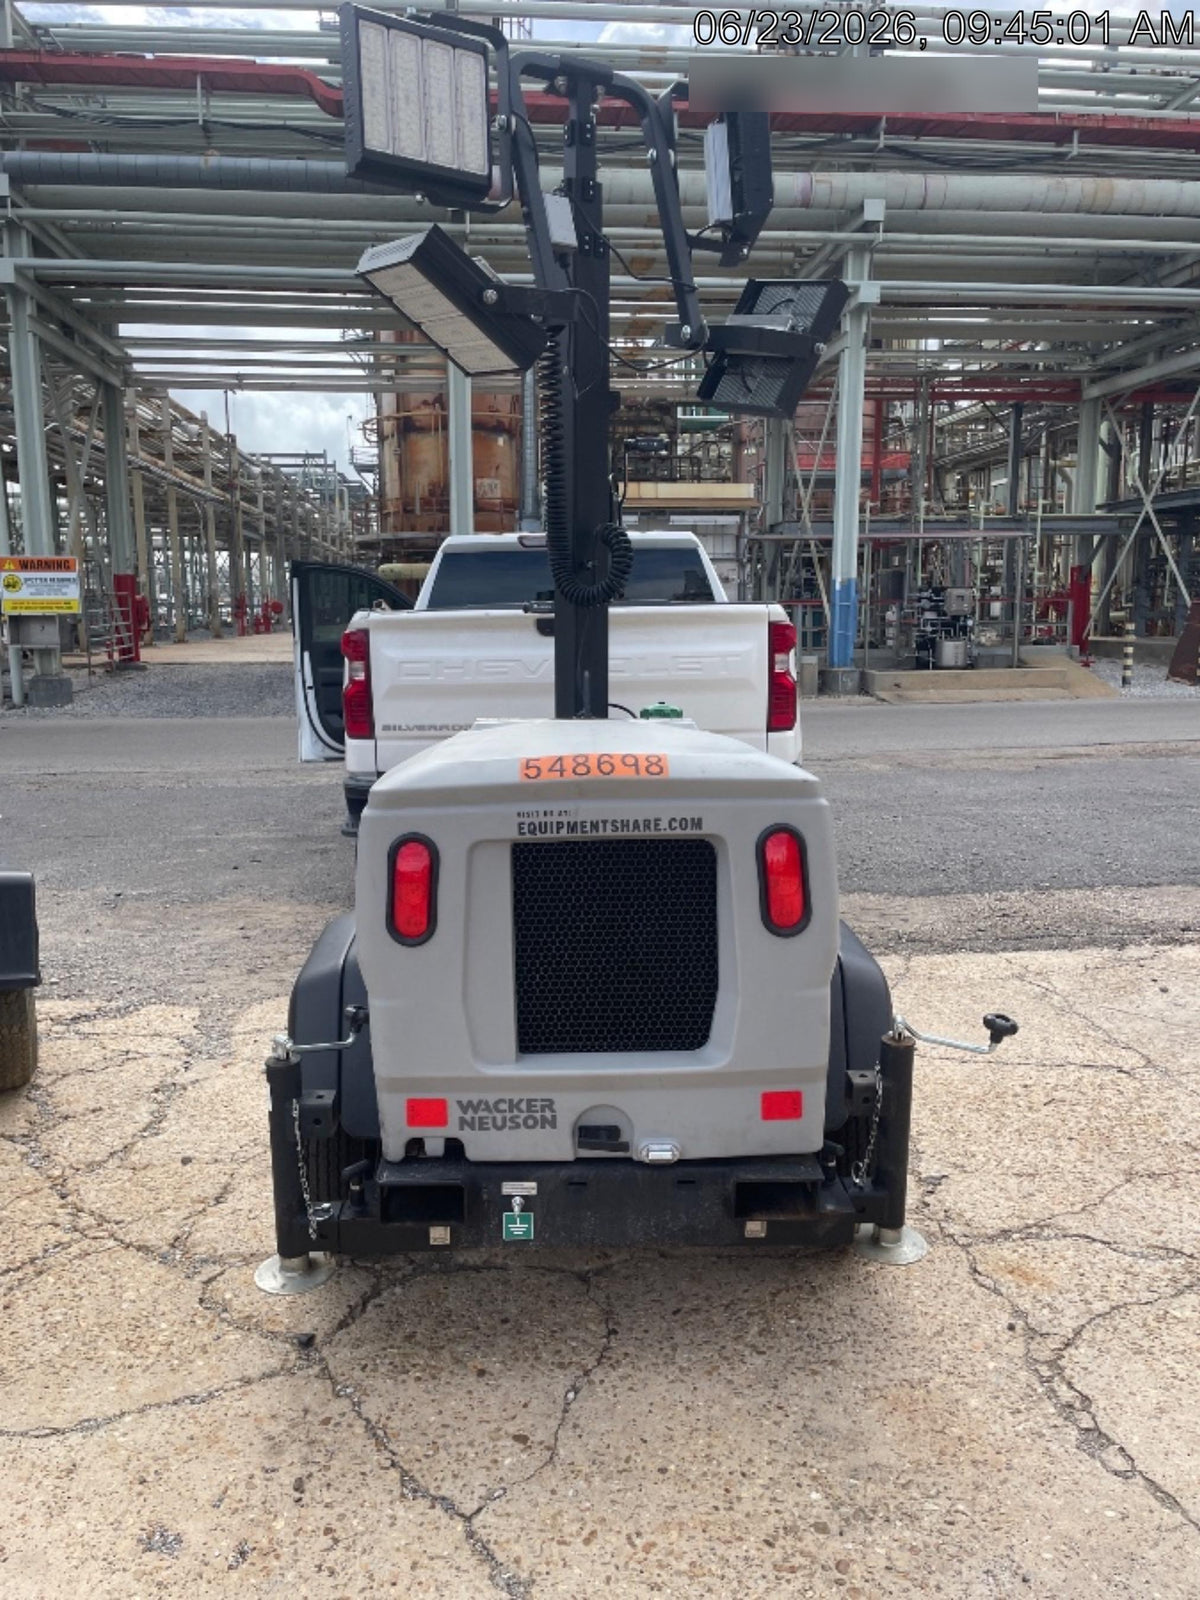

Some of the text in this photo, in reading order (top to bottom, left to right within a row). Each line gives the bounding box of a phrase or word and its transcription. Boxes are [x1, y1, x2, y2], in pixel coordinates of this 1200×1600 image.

[19, 559, 70, 570] WARNING
[399, 654, 742, 682] CHEVOLET
[523, 753, 664, 780] 548698
[517, 817, 704, 836] EQUIPMENTSHARE.COM
[456, 1098, 557, 1115] WACKER
[458, 1114, 558, 1132] NEUSON
